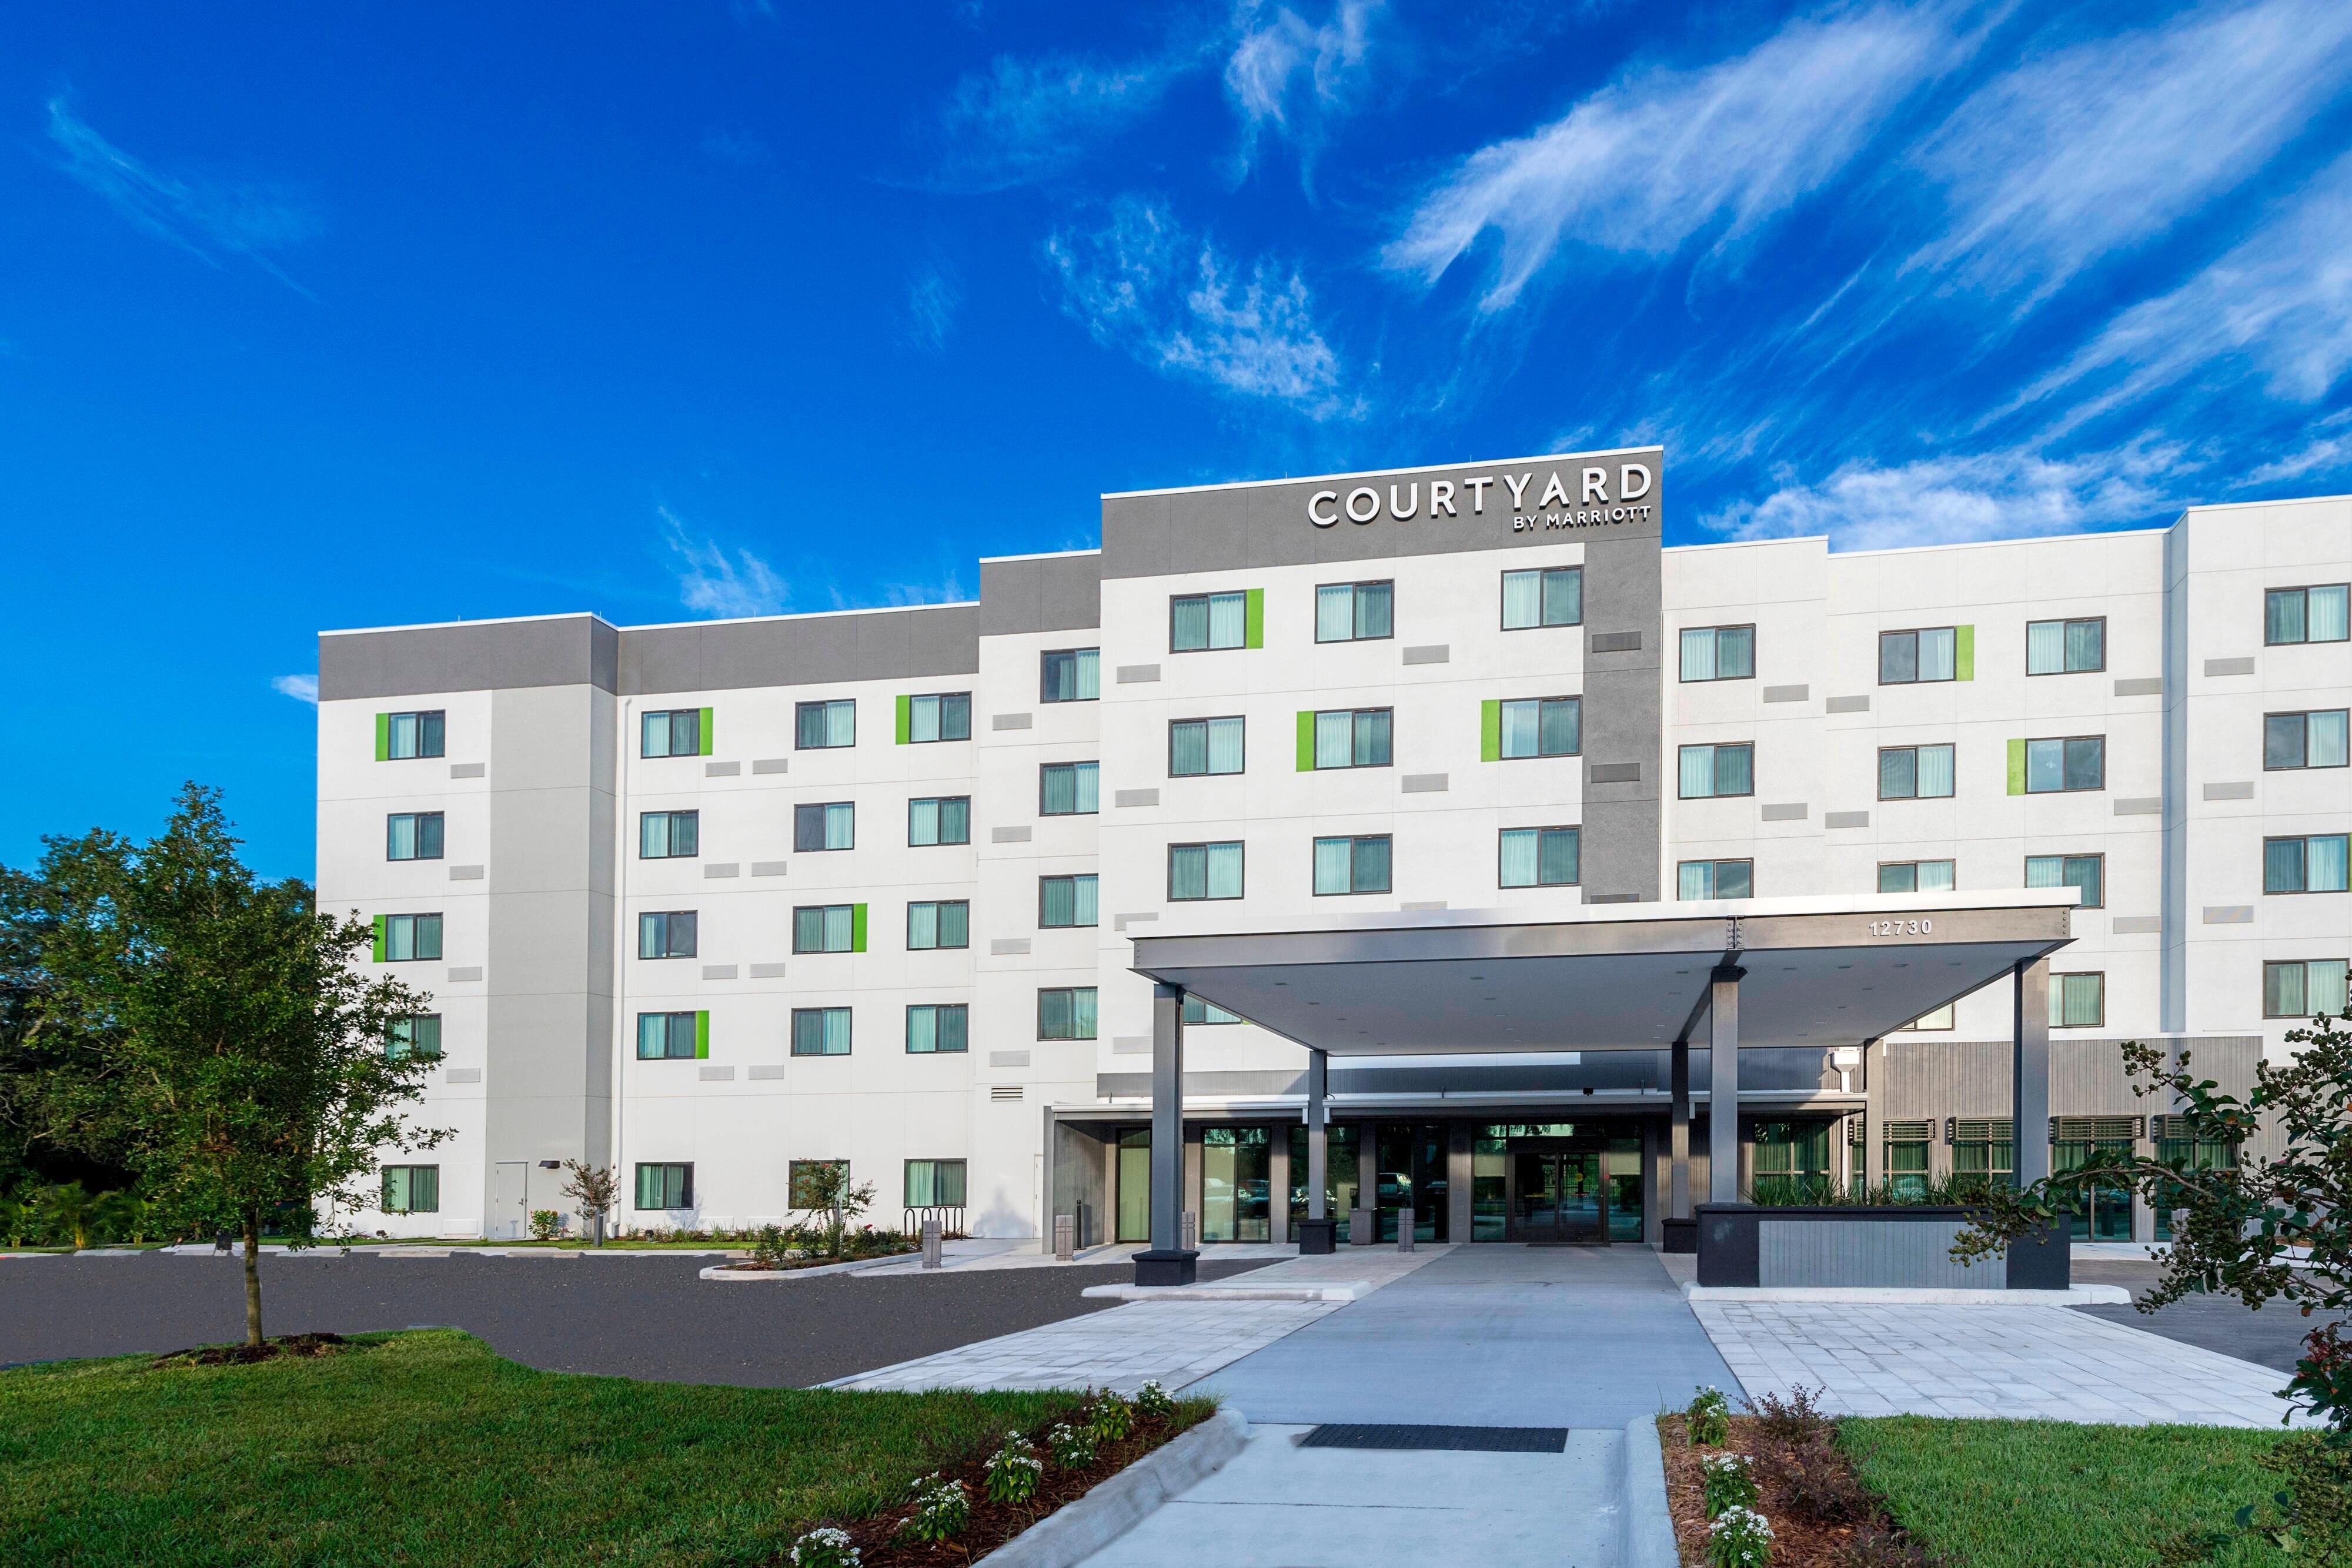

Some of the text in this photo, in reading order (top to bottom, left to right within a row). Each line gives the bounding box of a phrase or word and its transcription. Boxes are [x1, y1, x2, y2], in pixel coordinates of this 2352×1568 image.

[1307, 463, 1652, 527] COURTYARD
[1514, 505, 1651, 531] BY MARRIOTT
[1869, 920, 1932, 936] 12730
